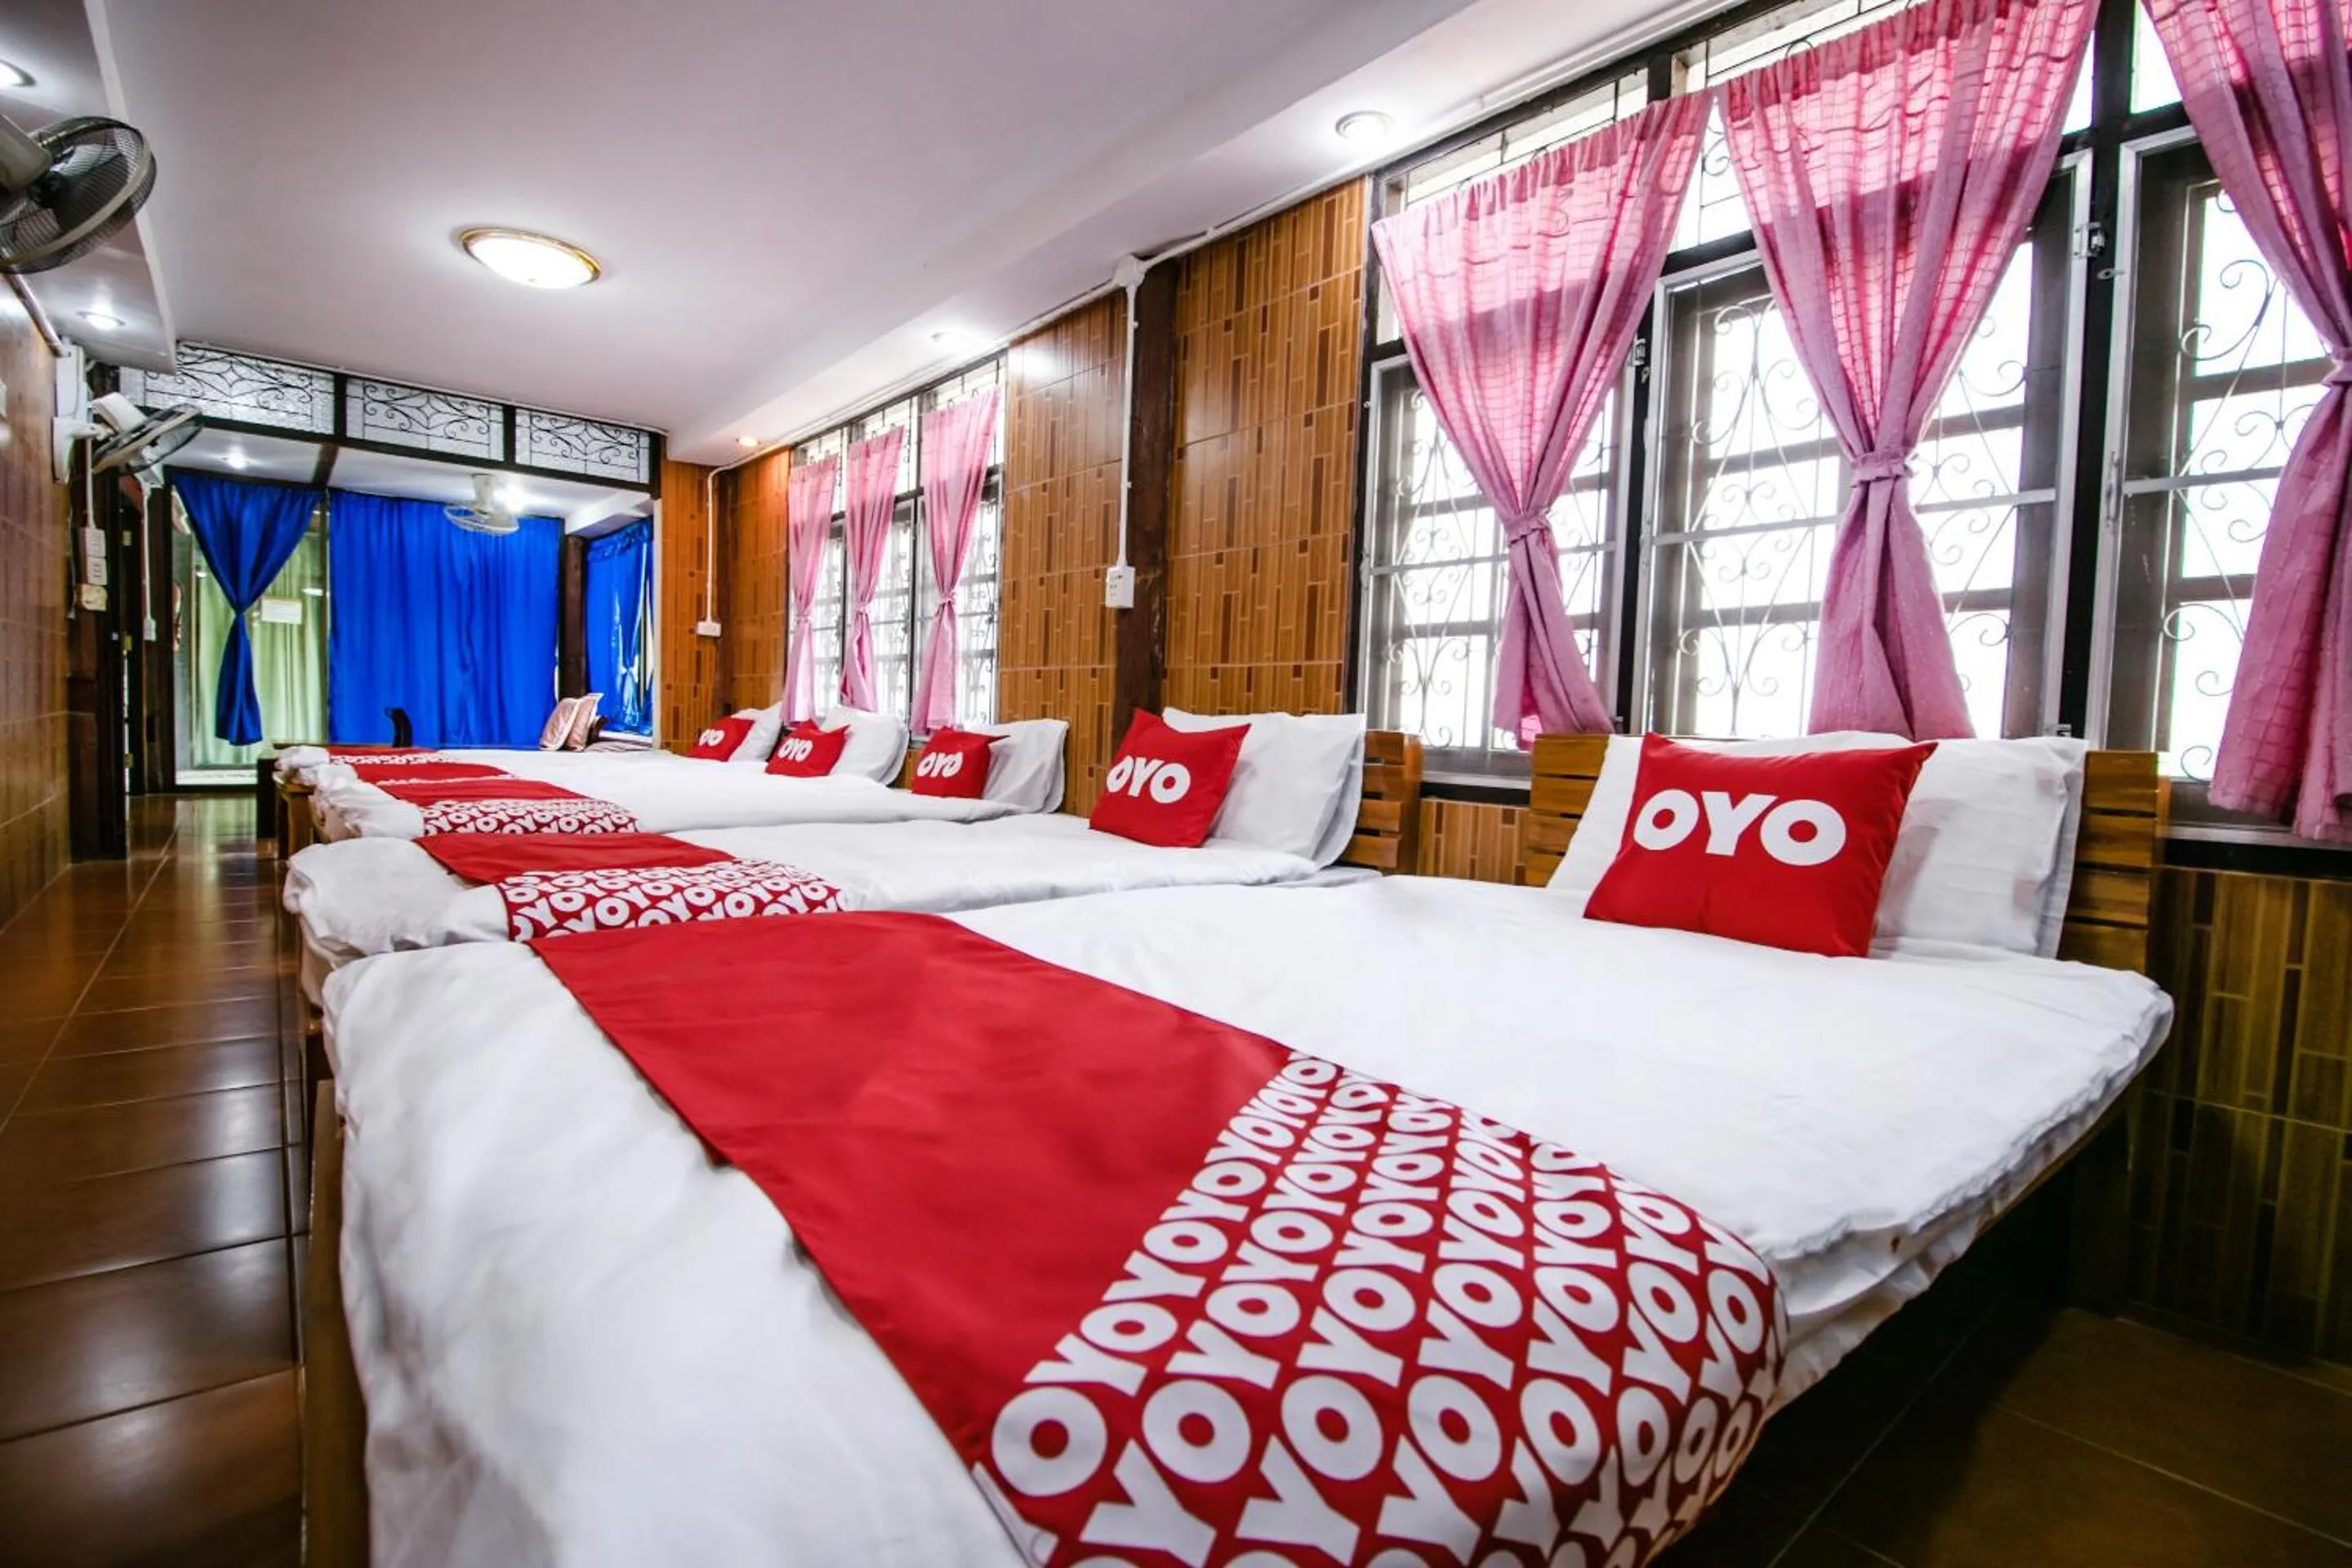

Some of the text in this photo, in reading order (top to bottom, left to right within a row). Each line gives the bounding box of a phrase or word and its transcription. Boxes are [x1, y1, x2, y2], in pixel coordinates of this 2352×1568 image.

[777, 737, 813, 762] OYO
[916, 751, 964, 778] OYO
[1106, 755, 1191, 804] OYO
[1633, 789, 1846, 866] OYO
